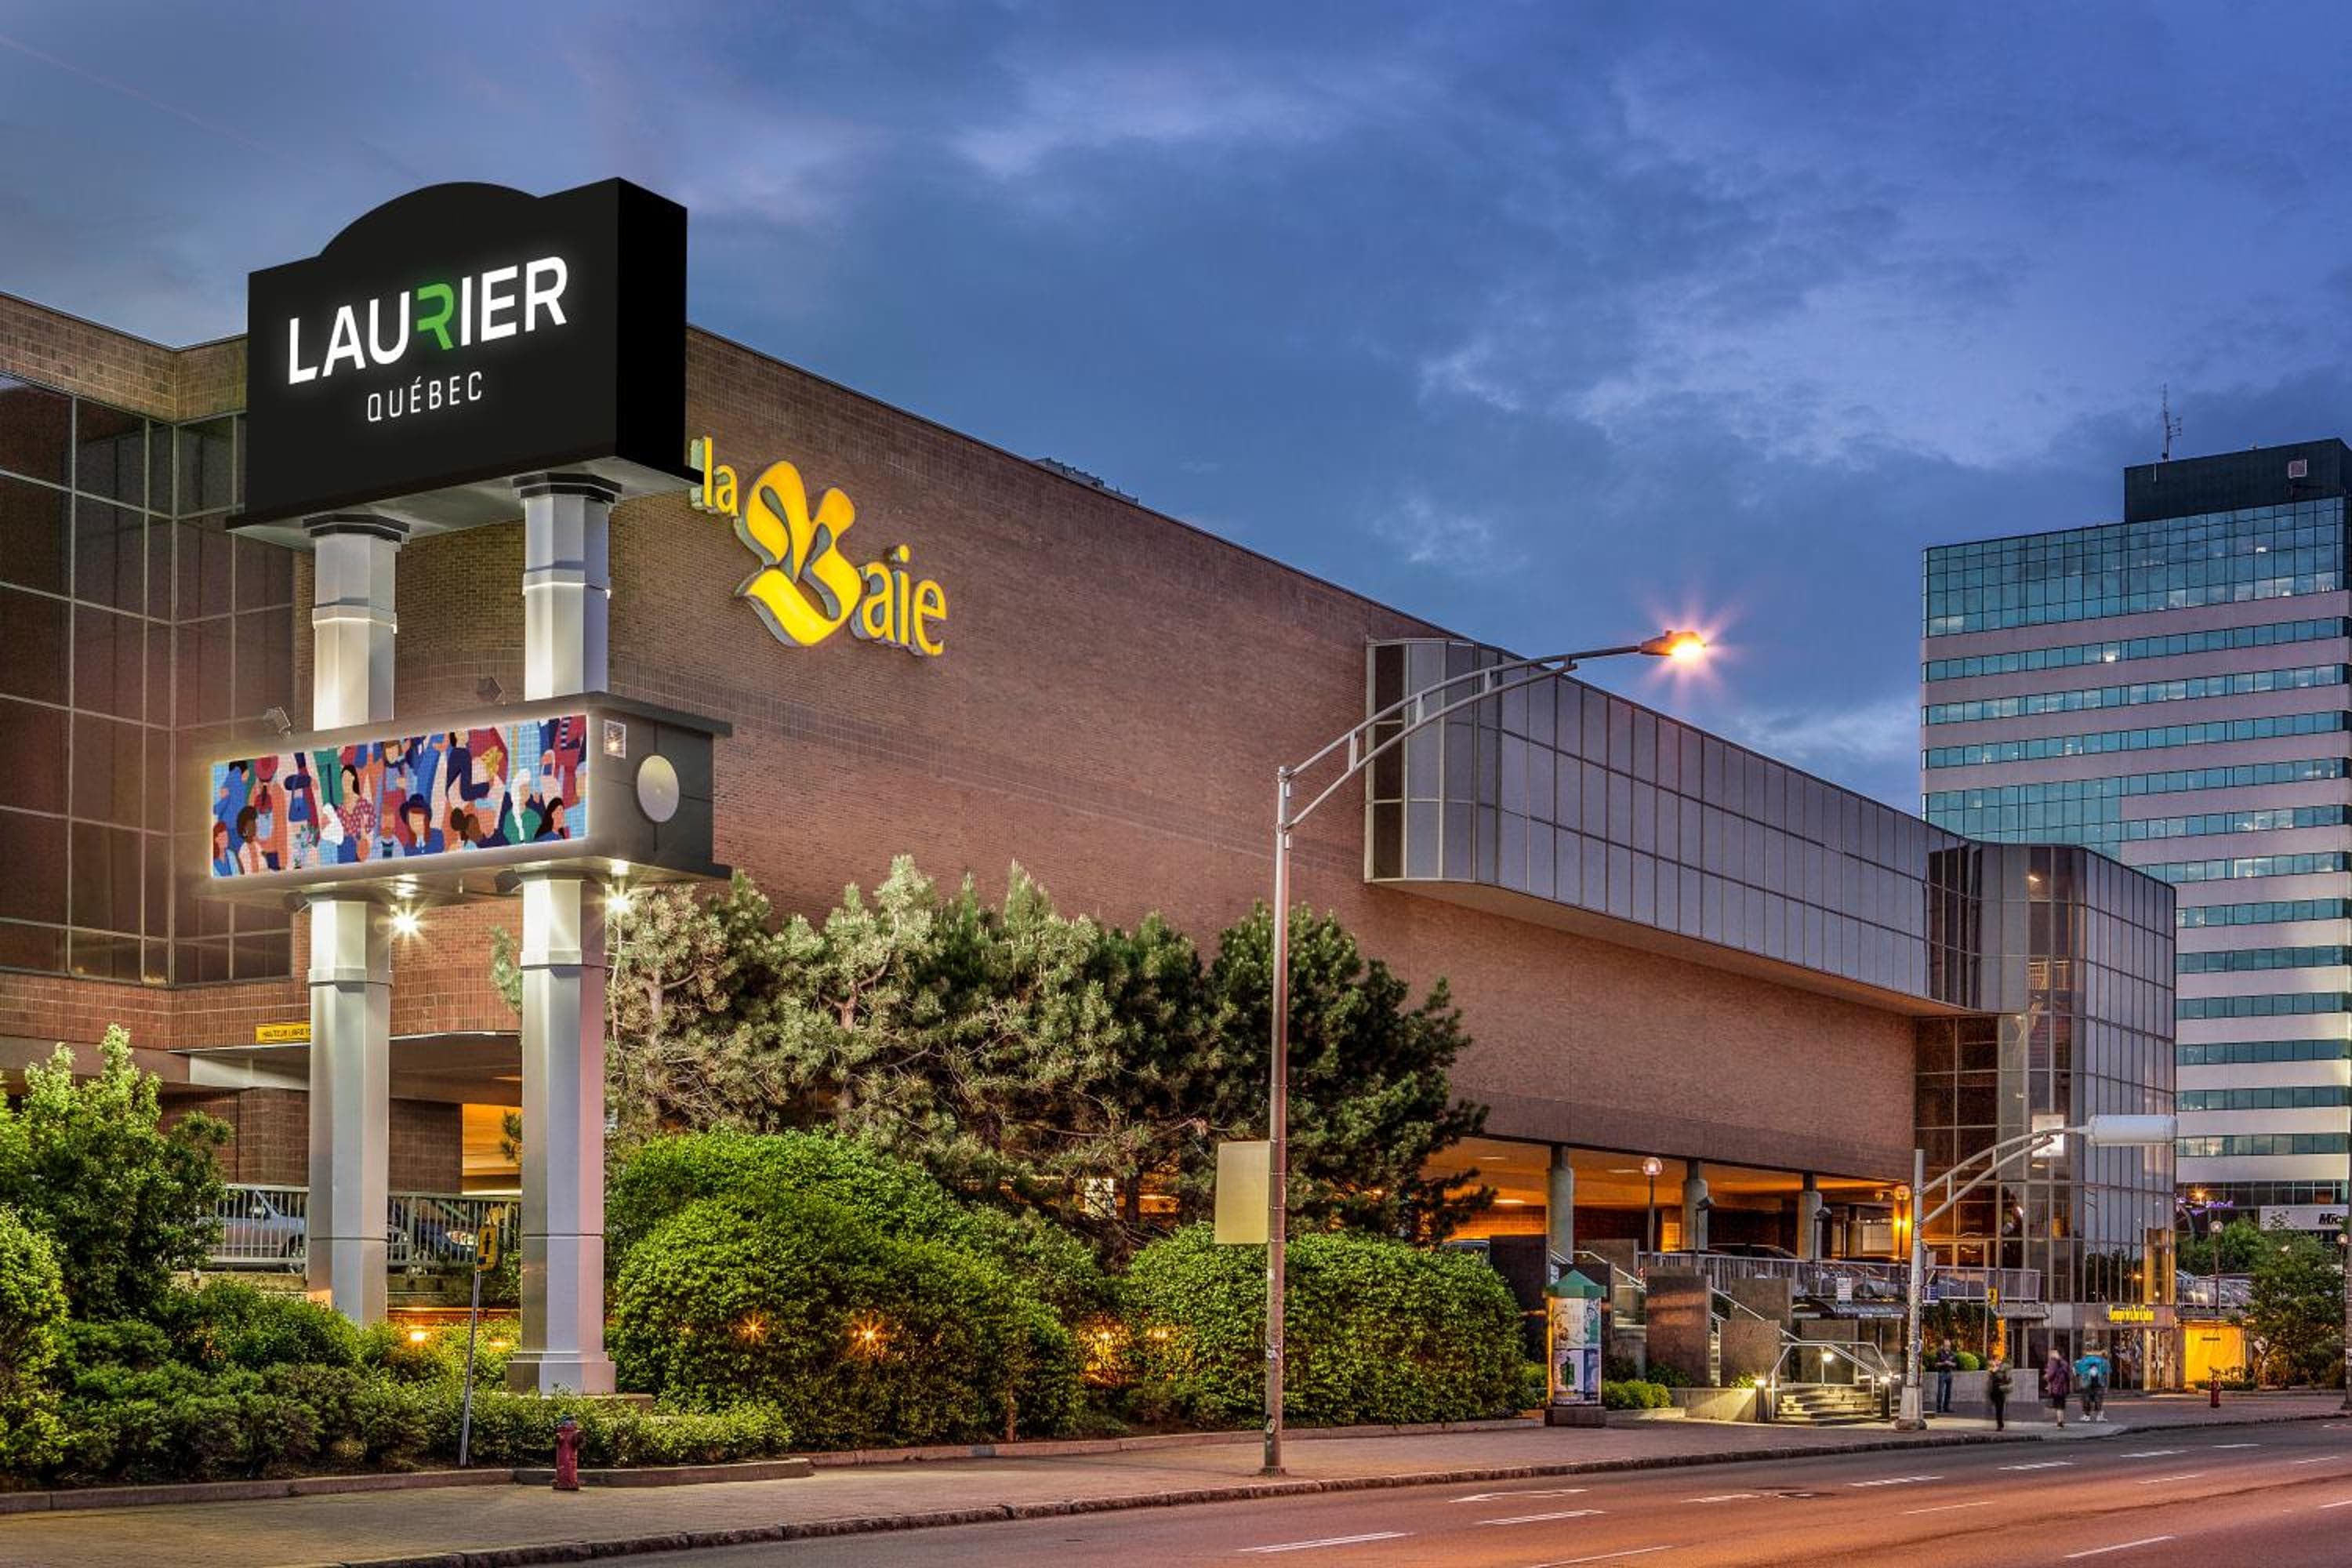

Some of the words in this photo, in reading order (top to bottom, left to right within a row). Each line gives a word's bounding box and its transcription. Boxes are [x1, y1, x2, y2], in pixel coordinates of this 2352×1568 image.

[288, 256, 568, 385] LAURIER
[366, 372, 483, 423] QUÉBEC
[702, 436, 739, 517] la
[745, 460, 949, 657] Baie
